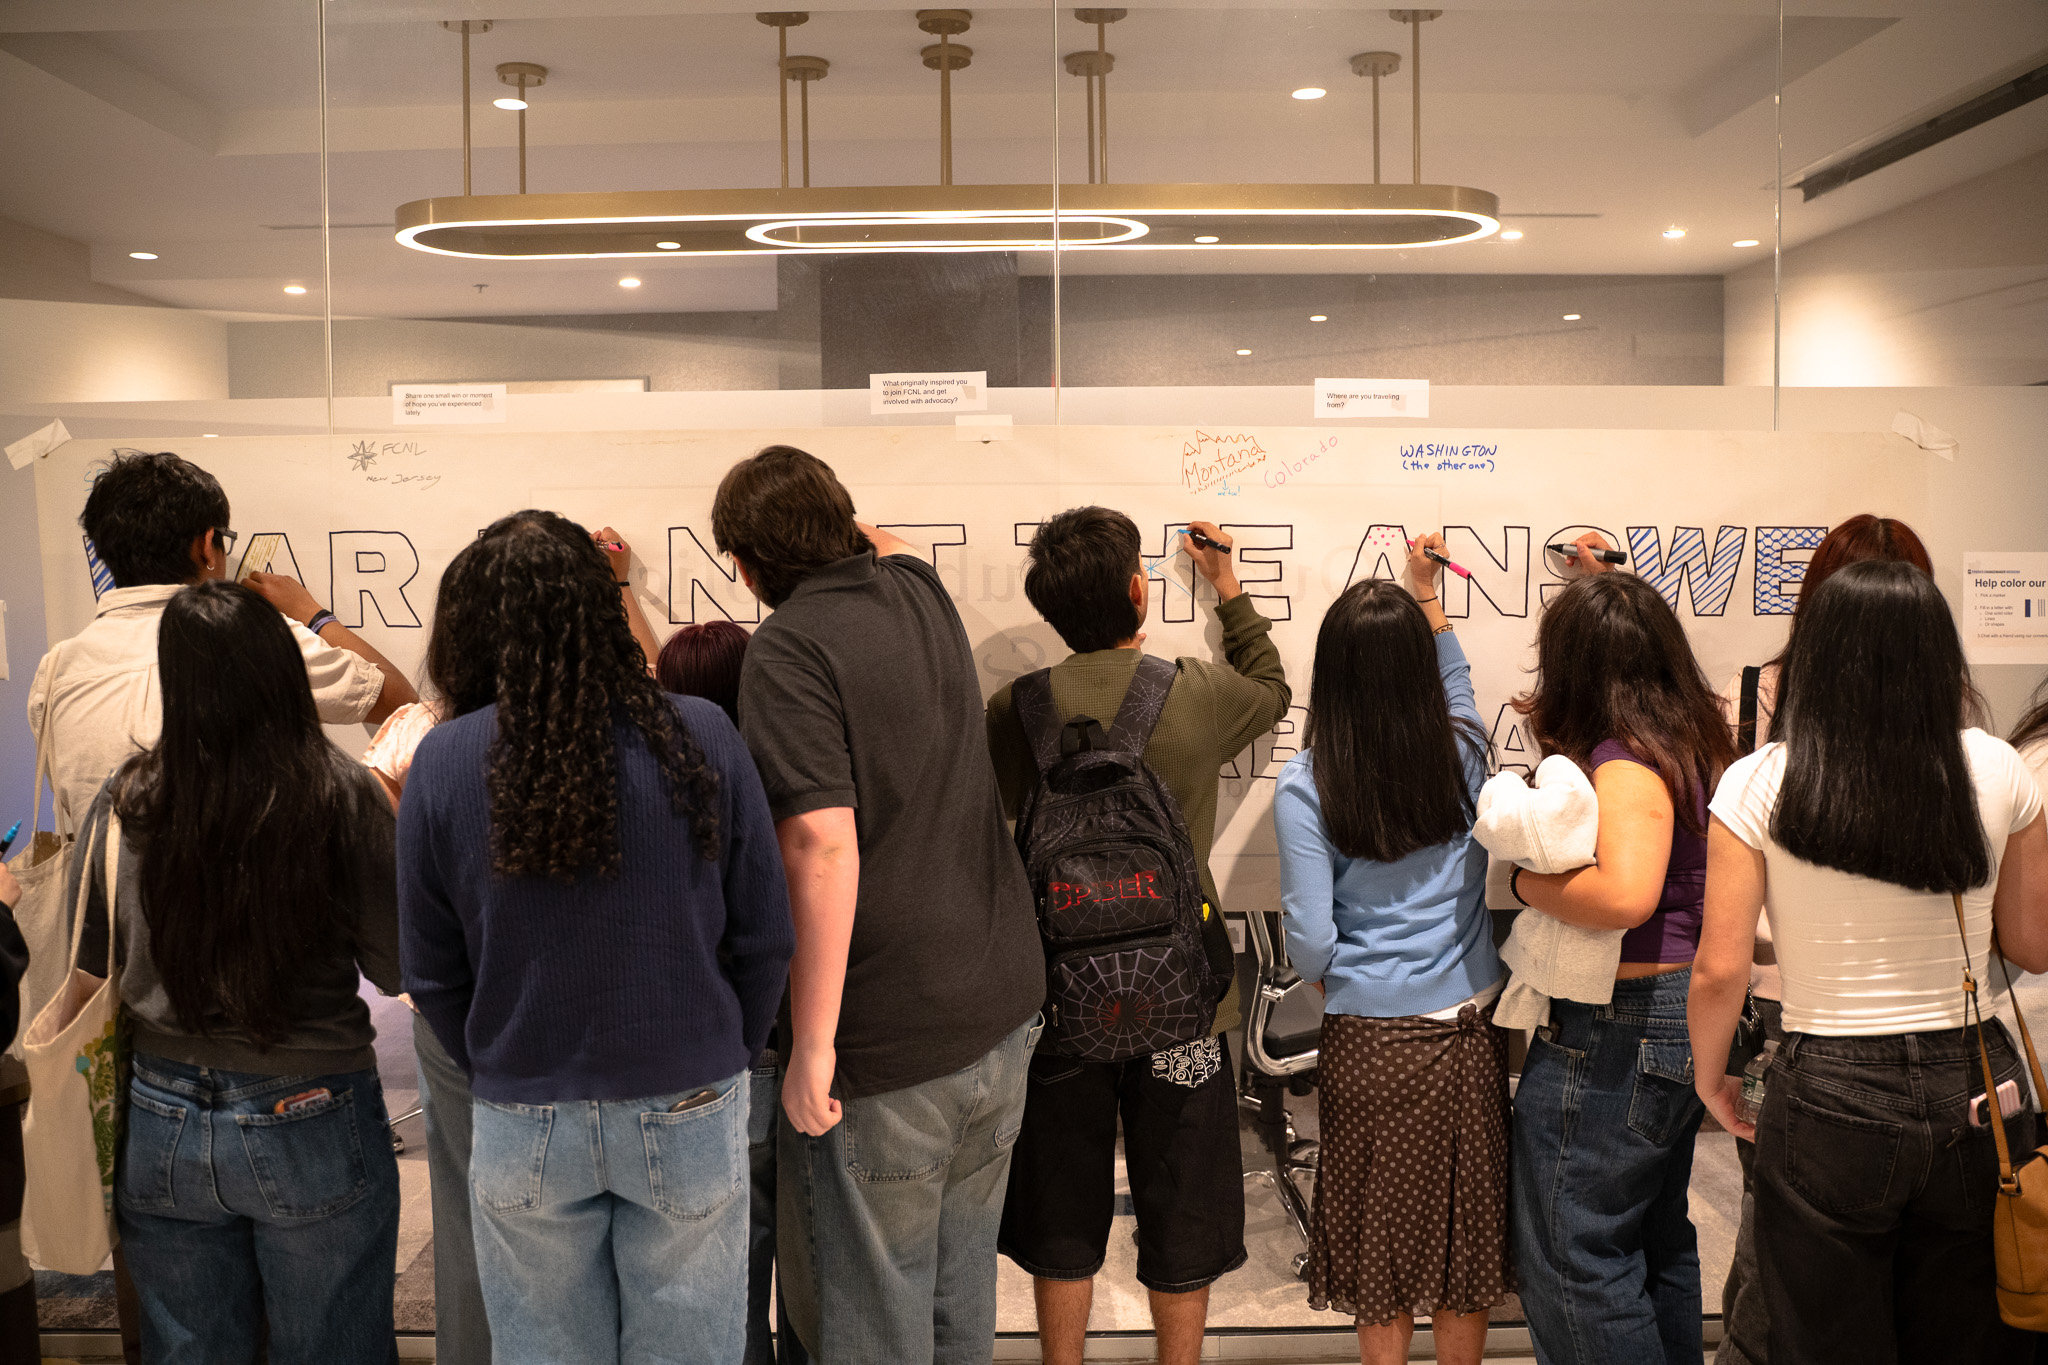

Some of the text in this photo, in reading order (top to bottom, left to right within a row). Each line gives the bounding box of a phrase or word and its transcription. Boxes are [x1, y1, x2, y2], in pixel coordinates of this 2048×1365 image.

[382, 442, 427, 456] FCNL
[1400, 444, 1498, 458] WASHINGTON
[1185, 446, 1263, 489] Montana
[1264, 436, 1338, 489] Colorado
[1402, 458, 1495, 472] (the other one)
[392, 474, 442, 490] Jersey
[1975, 578, 1997, 589] Help
[2000, 578, 2026, 588] color
[1047, 870, 1162, 911] SPIDER
